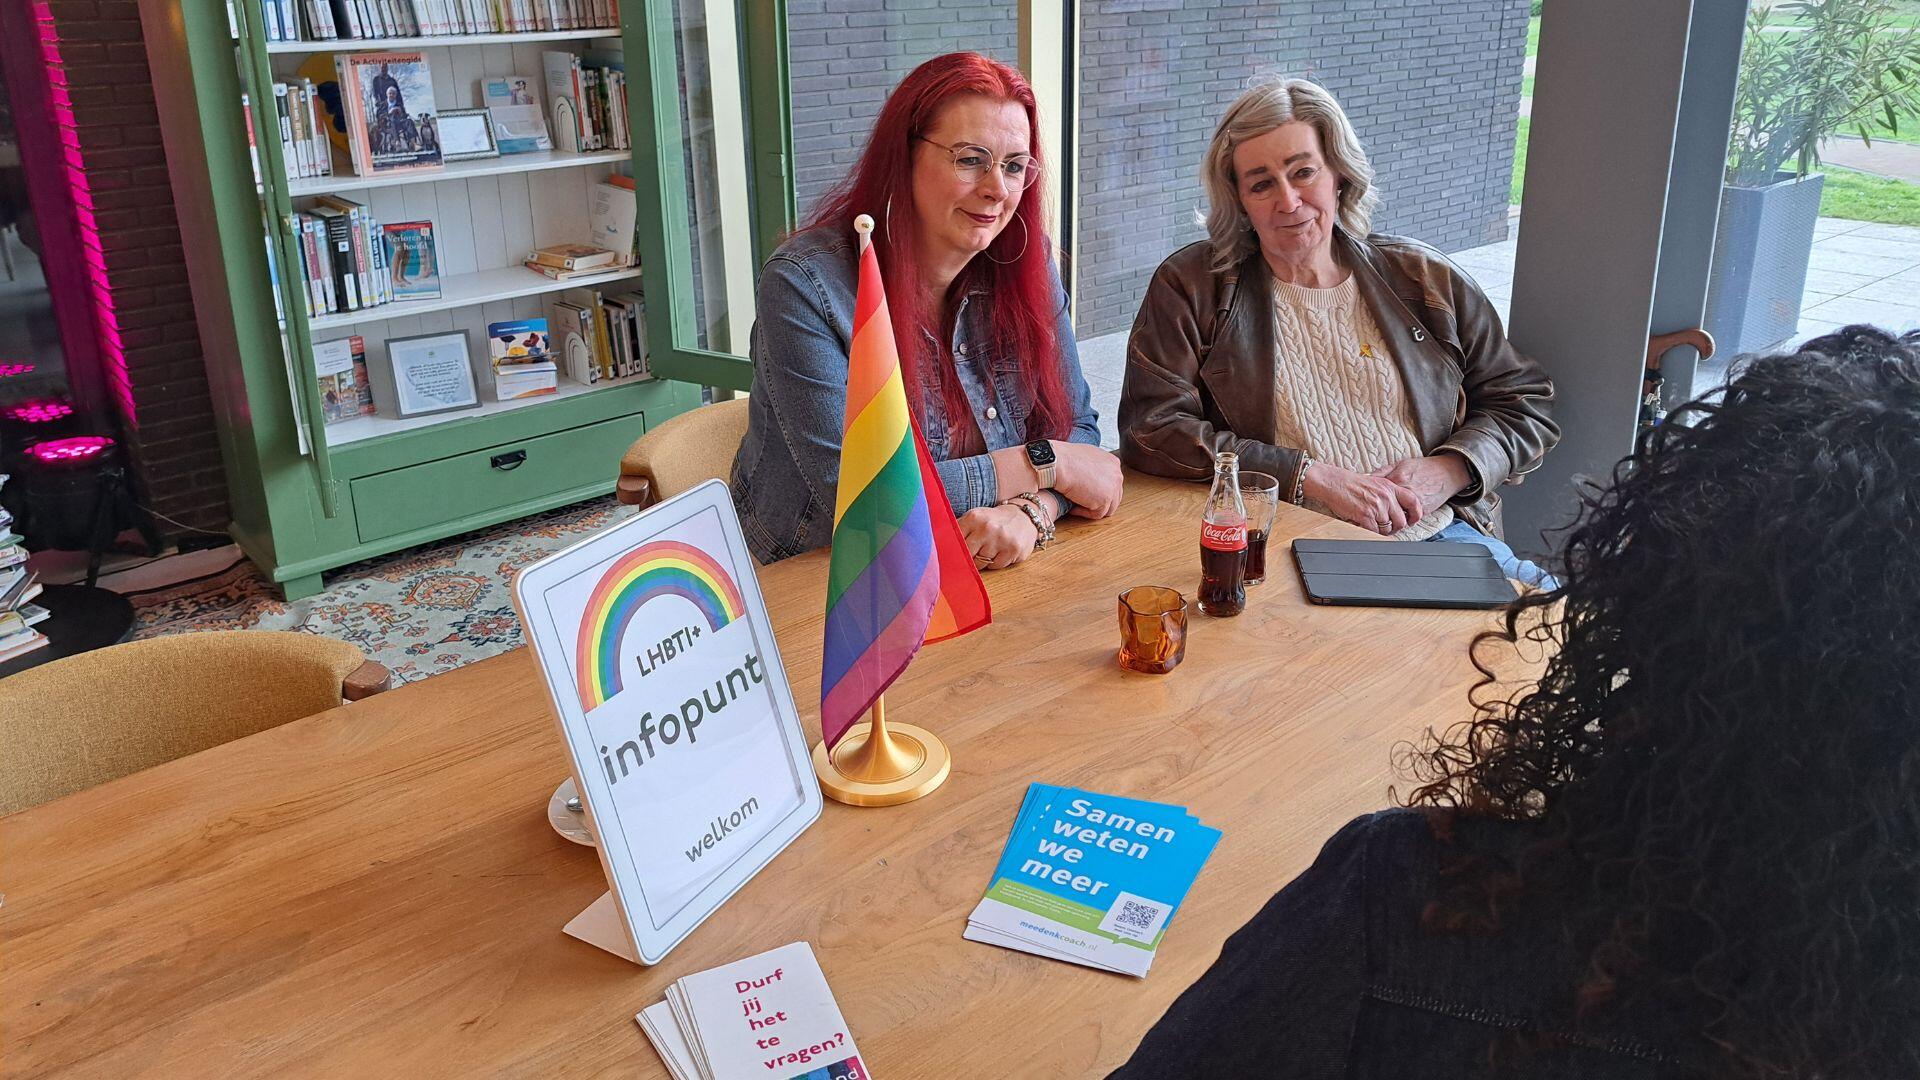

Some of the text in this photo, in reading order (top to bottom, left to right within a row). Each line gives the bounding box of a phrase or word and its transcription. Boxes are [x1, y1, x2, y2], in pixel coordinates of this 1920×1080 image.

[350, 56, 422, 66] De Activiteitengids
[636, 625, 701, 677] LHBTI+
[600, 653, 763, 786] infopunt
[685, 796, 759, 863] welkom
[1064, 799, 1176, 843] Samen
[1038, 838, 1083, 864] we
[1053, 819, 1149, 860] weten
[1020, 859, 1109, 896] meer
[1019, 920, 1098, 952] meedenkcoach.nl
[735, 968, 784, 994] Durf
[742, 996, 762, 1016] jij
[748, 1010, 788, 1031] het
[755, 1035, 780, 1050] te
[763, 1032, 844, 1070] vragen?
